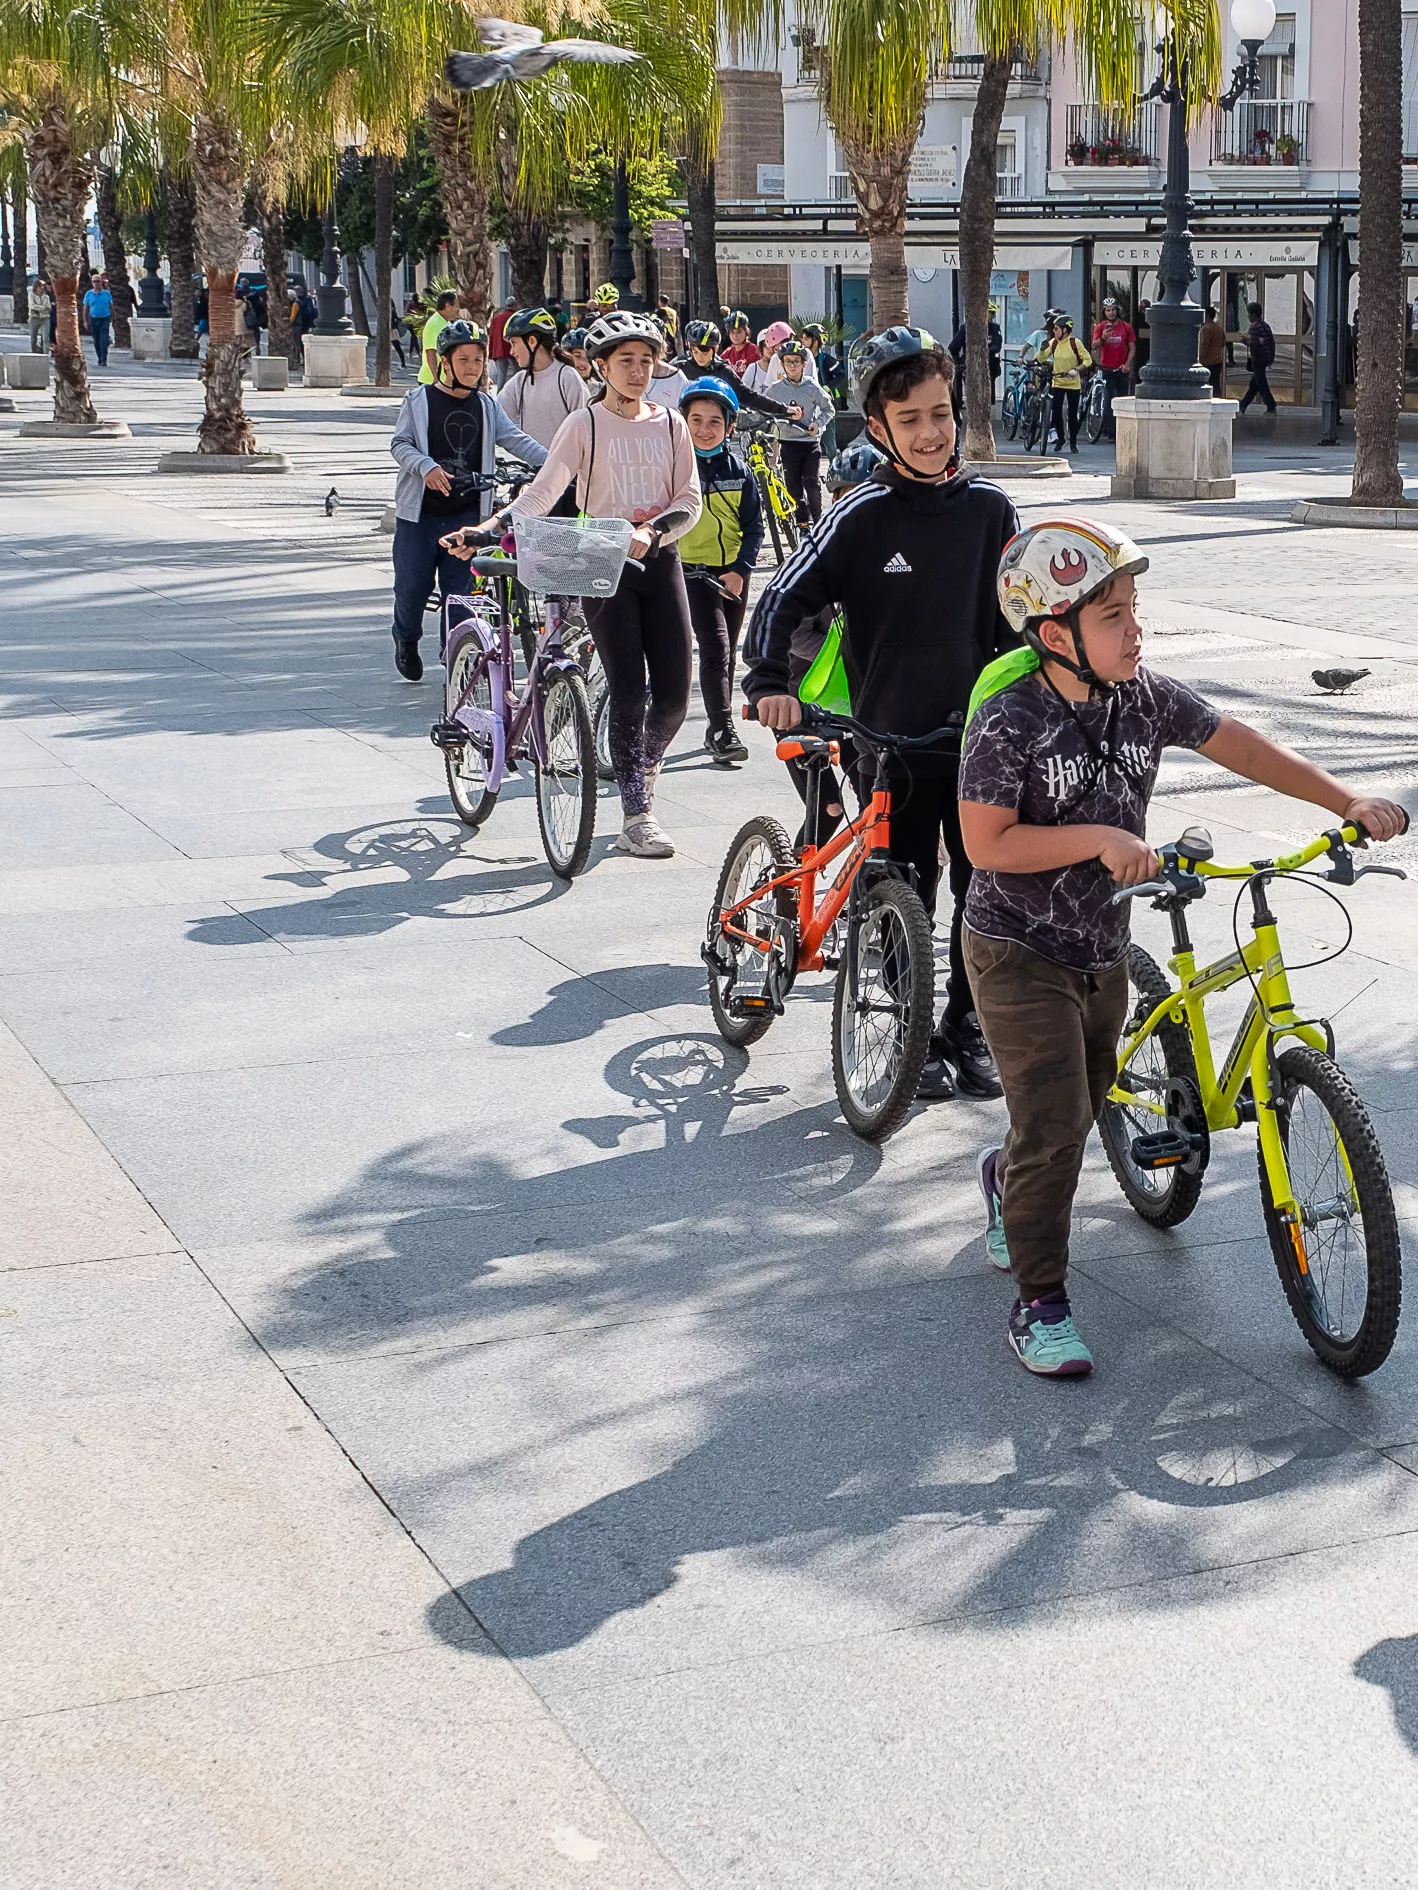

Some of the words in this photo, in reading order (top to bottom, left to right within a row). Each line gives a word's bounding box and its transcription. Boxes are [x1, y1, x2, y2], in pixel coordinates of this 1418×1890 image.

[755, 248, 860, 258] CERVECERÍA
[1117, 248, 1243, 259] CERVERÍA
[607, 437, 632, 464] ALL
[609, 464, 664, 506] NEED
[883, 565, 912, 573] adidas
